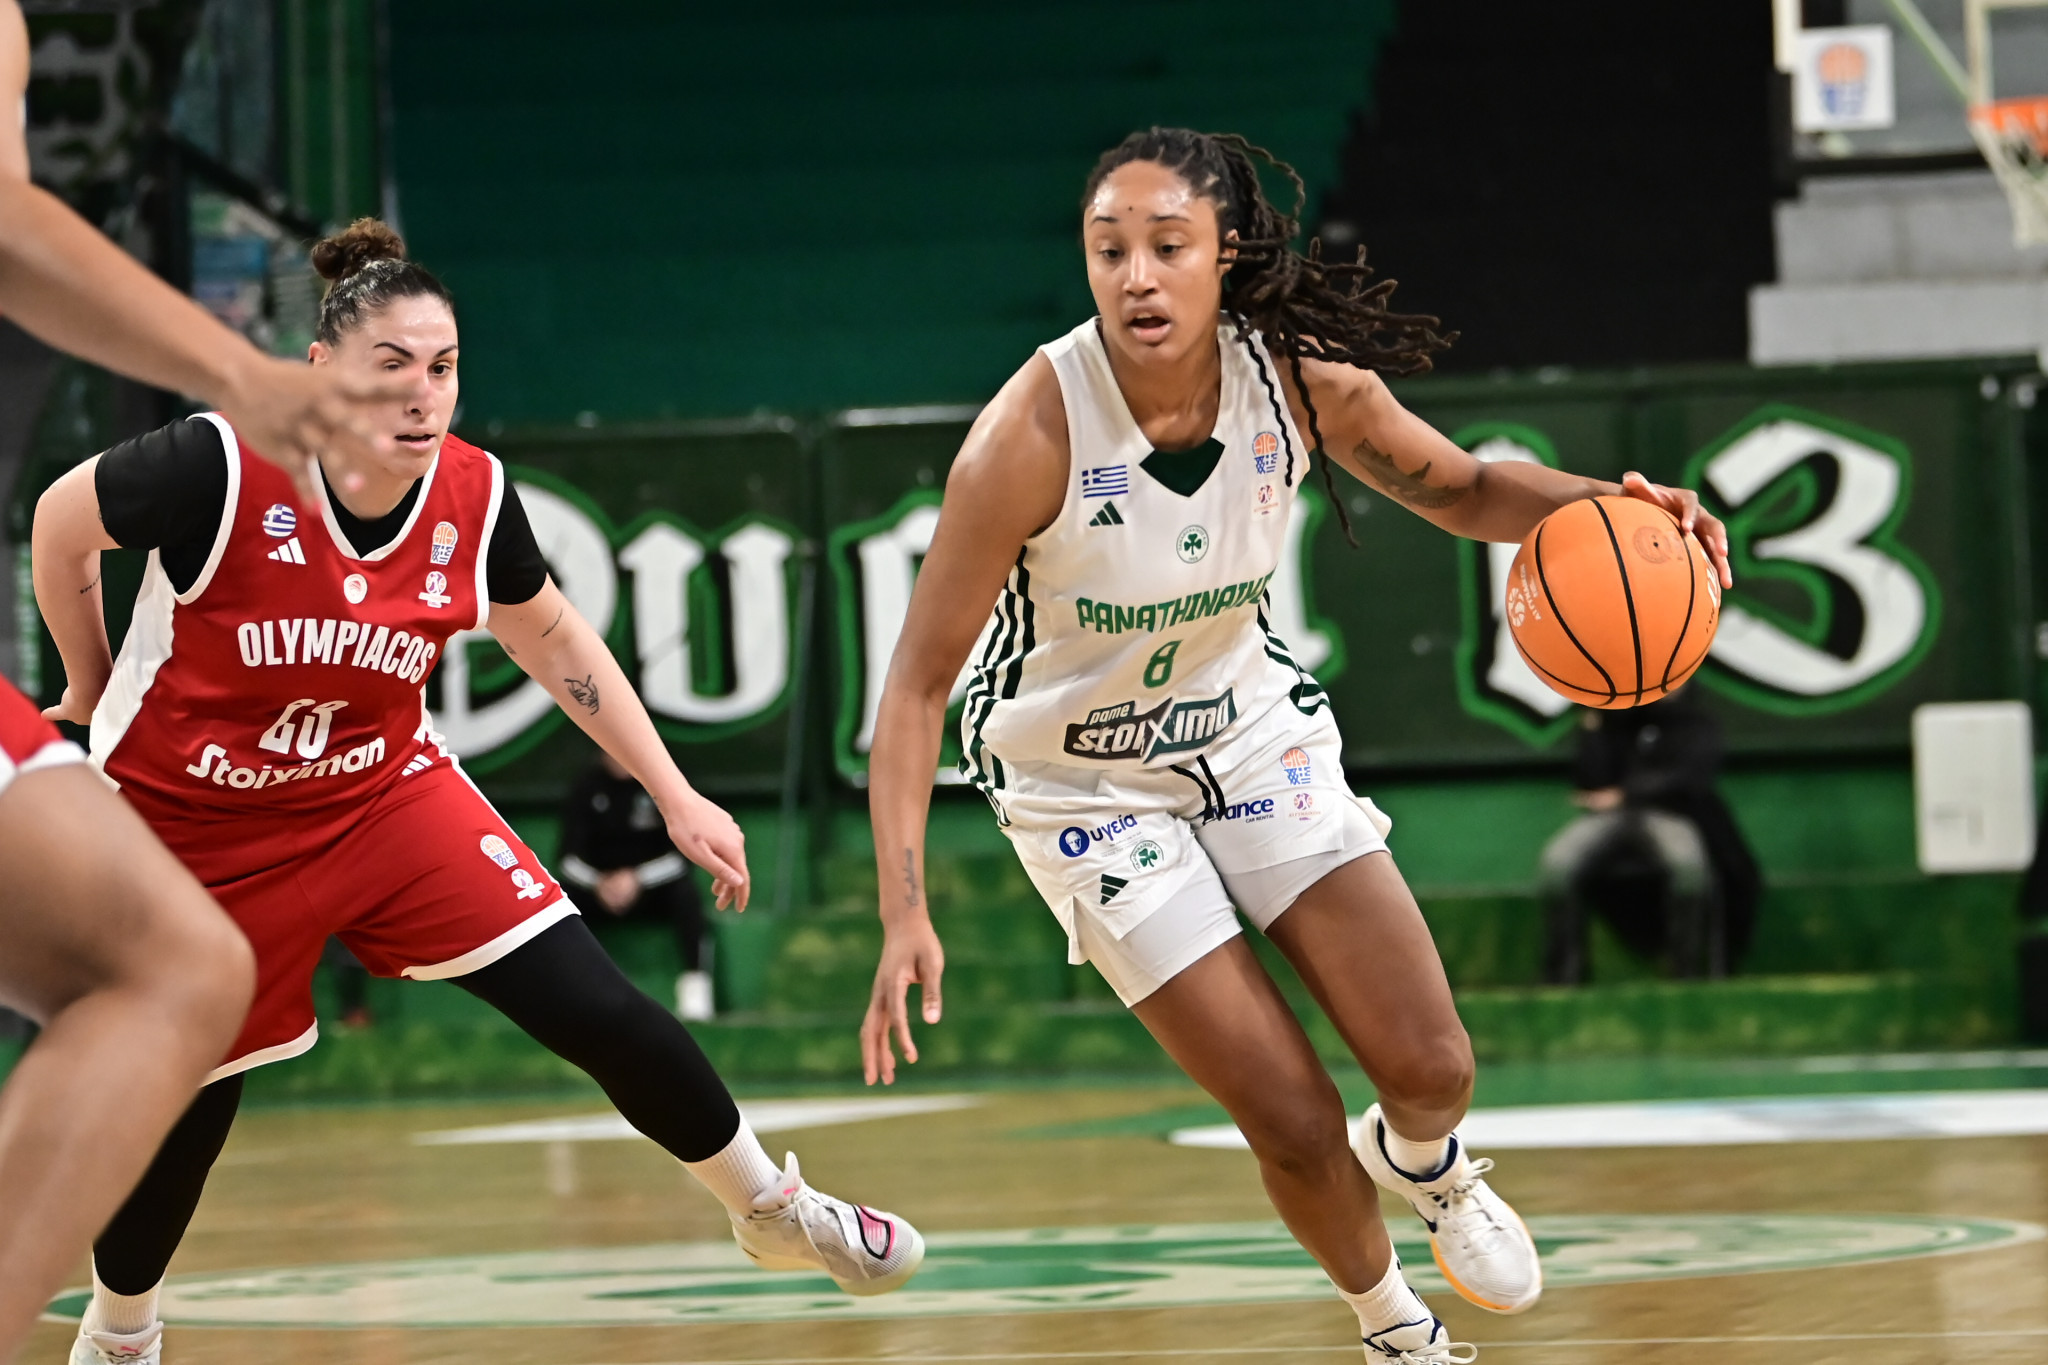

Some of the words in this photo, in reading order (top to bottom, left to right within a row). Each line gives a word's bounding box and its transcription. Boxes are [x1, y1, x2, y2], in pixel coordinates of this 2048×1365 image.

[237, 618, 437, 685] OLYMPIACOS
[1142, 639, 1183, 689] 8
[1089, 704, 1131, 725] pame
[185, 736, 386, 790] Stoiximan
[1089, 813, 1138, 842] υγεία
[1245, 816, 1255, 824] CAR
[1256, 813, 1275, 822] RENTAL
